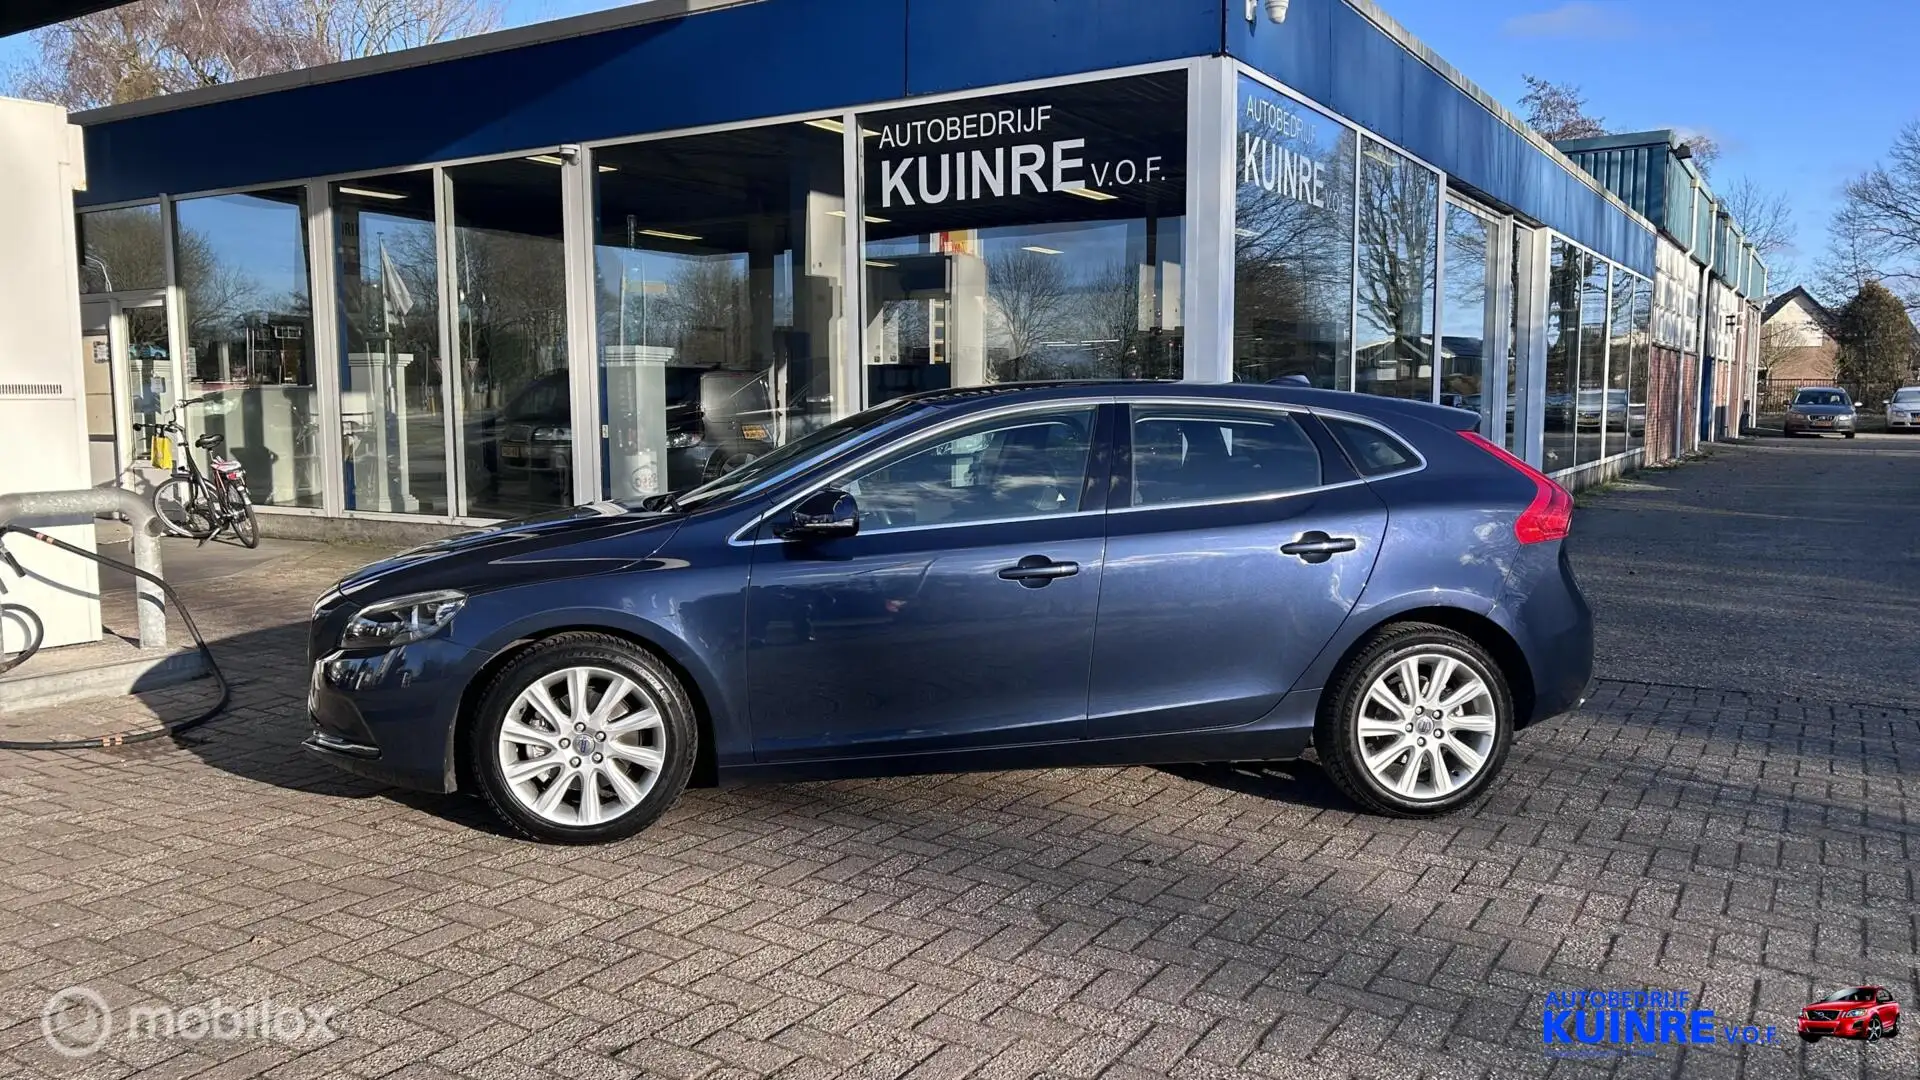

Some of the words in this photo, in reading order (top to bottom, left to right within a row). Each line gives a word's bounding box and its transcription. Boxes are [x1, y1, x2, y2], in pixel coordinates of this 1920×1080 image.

[879, 105, 1052, 149] AUTOBEDRIJF
[1246, 95, 1316, 144] AUTOBEDRIJF
[881, 138, 1086, 208] KUINRE
[1091, 156, 1166, 187] V.O.F.
[1244, 132, 1325, 209] KUINRE
